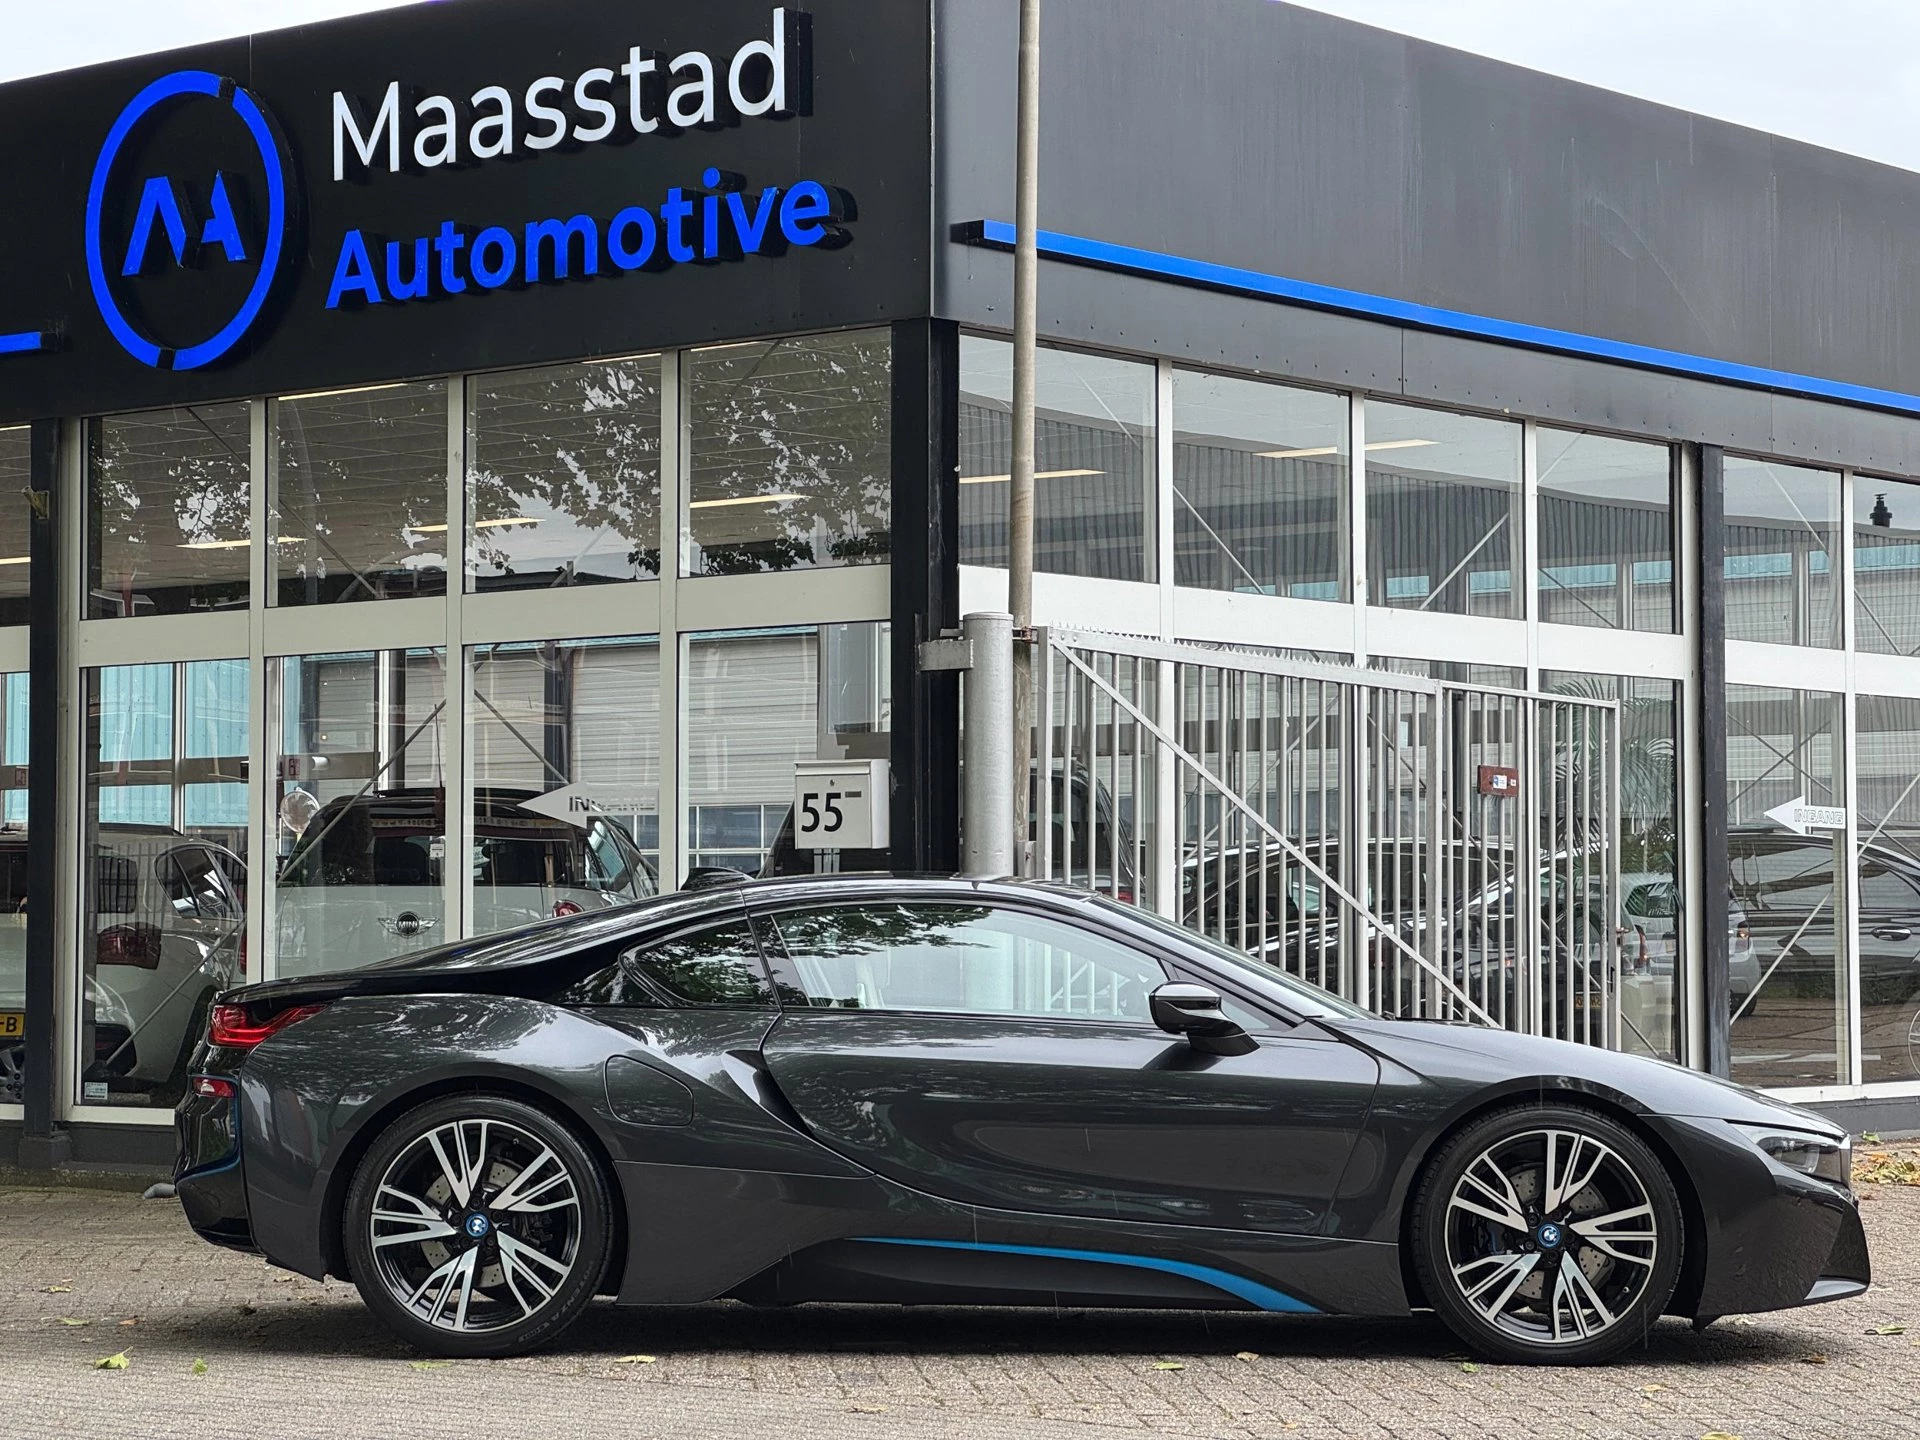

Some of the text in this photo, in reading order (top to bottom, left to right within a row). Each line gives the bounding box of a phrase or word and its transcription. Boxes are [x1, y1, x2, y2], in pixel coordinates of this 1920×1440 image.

[334, 7, 785, 181] Maasstad
[326, 167, 831, 309] Automotive
[801, 792, 843, 832] 55
[1793, 808, 1844, 825] INGANG
[398, 920, 418, 928] MINI
